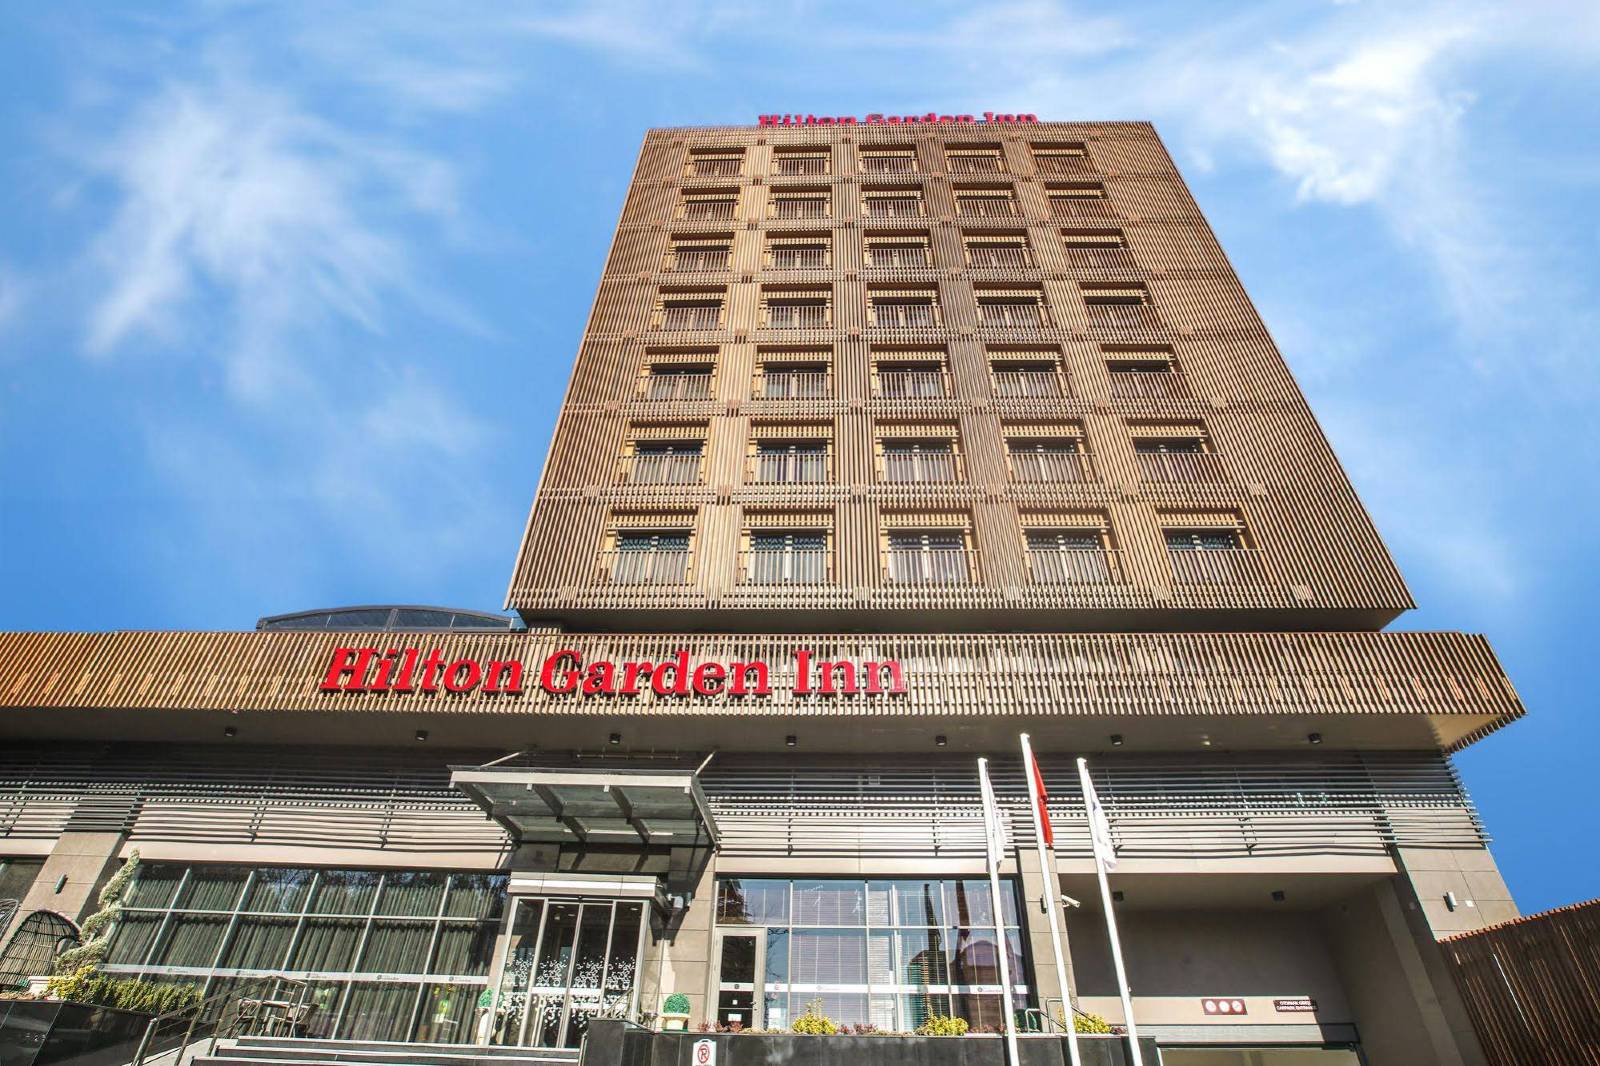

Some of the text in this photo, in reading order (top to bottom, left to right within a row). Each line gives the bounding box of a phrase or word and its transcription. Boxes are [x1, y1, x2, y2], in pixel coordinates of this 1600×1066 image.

[320, 647, 906, 695] Hilton Garden Inn
